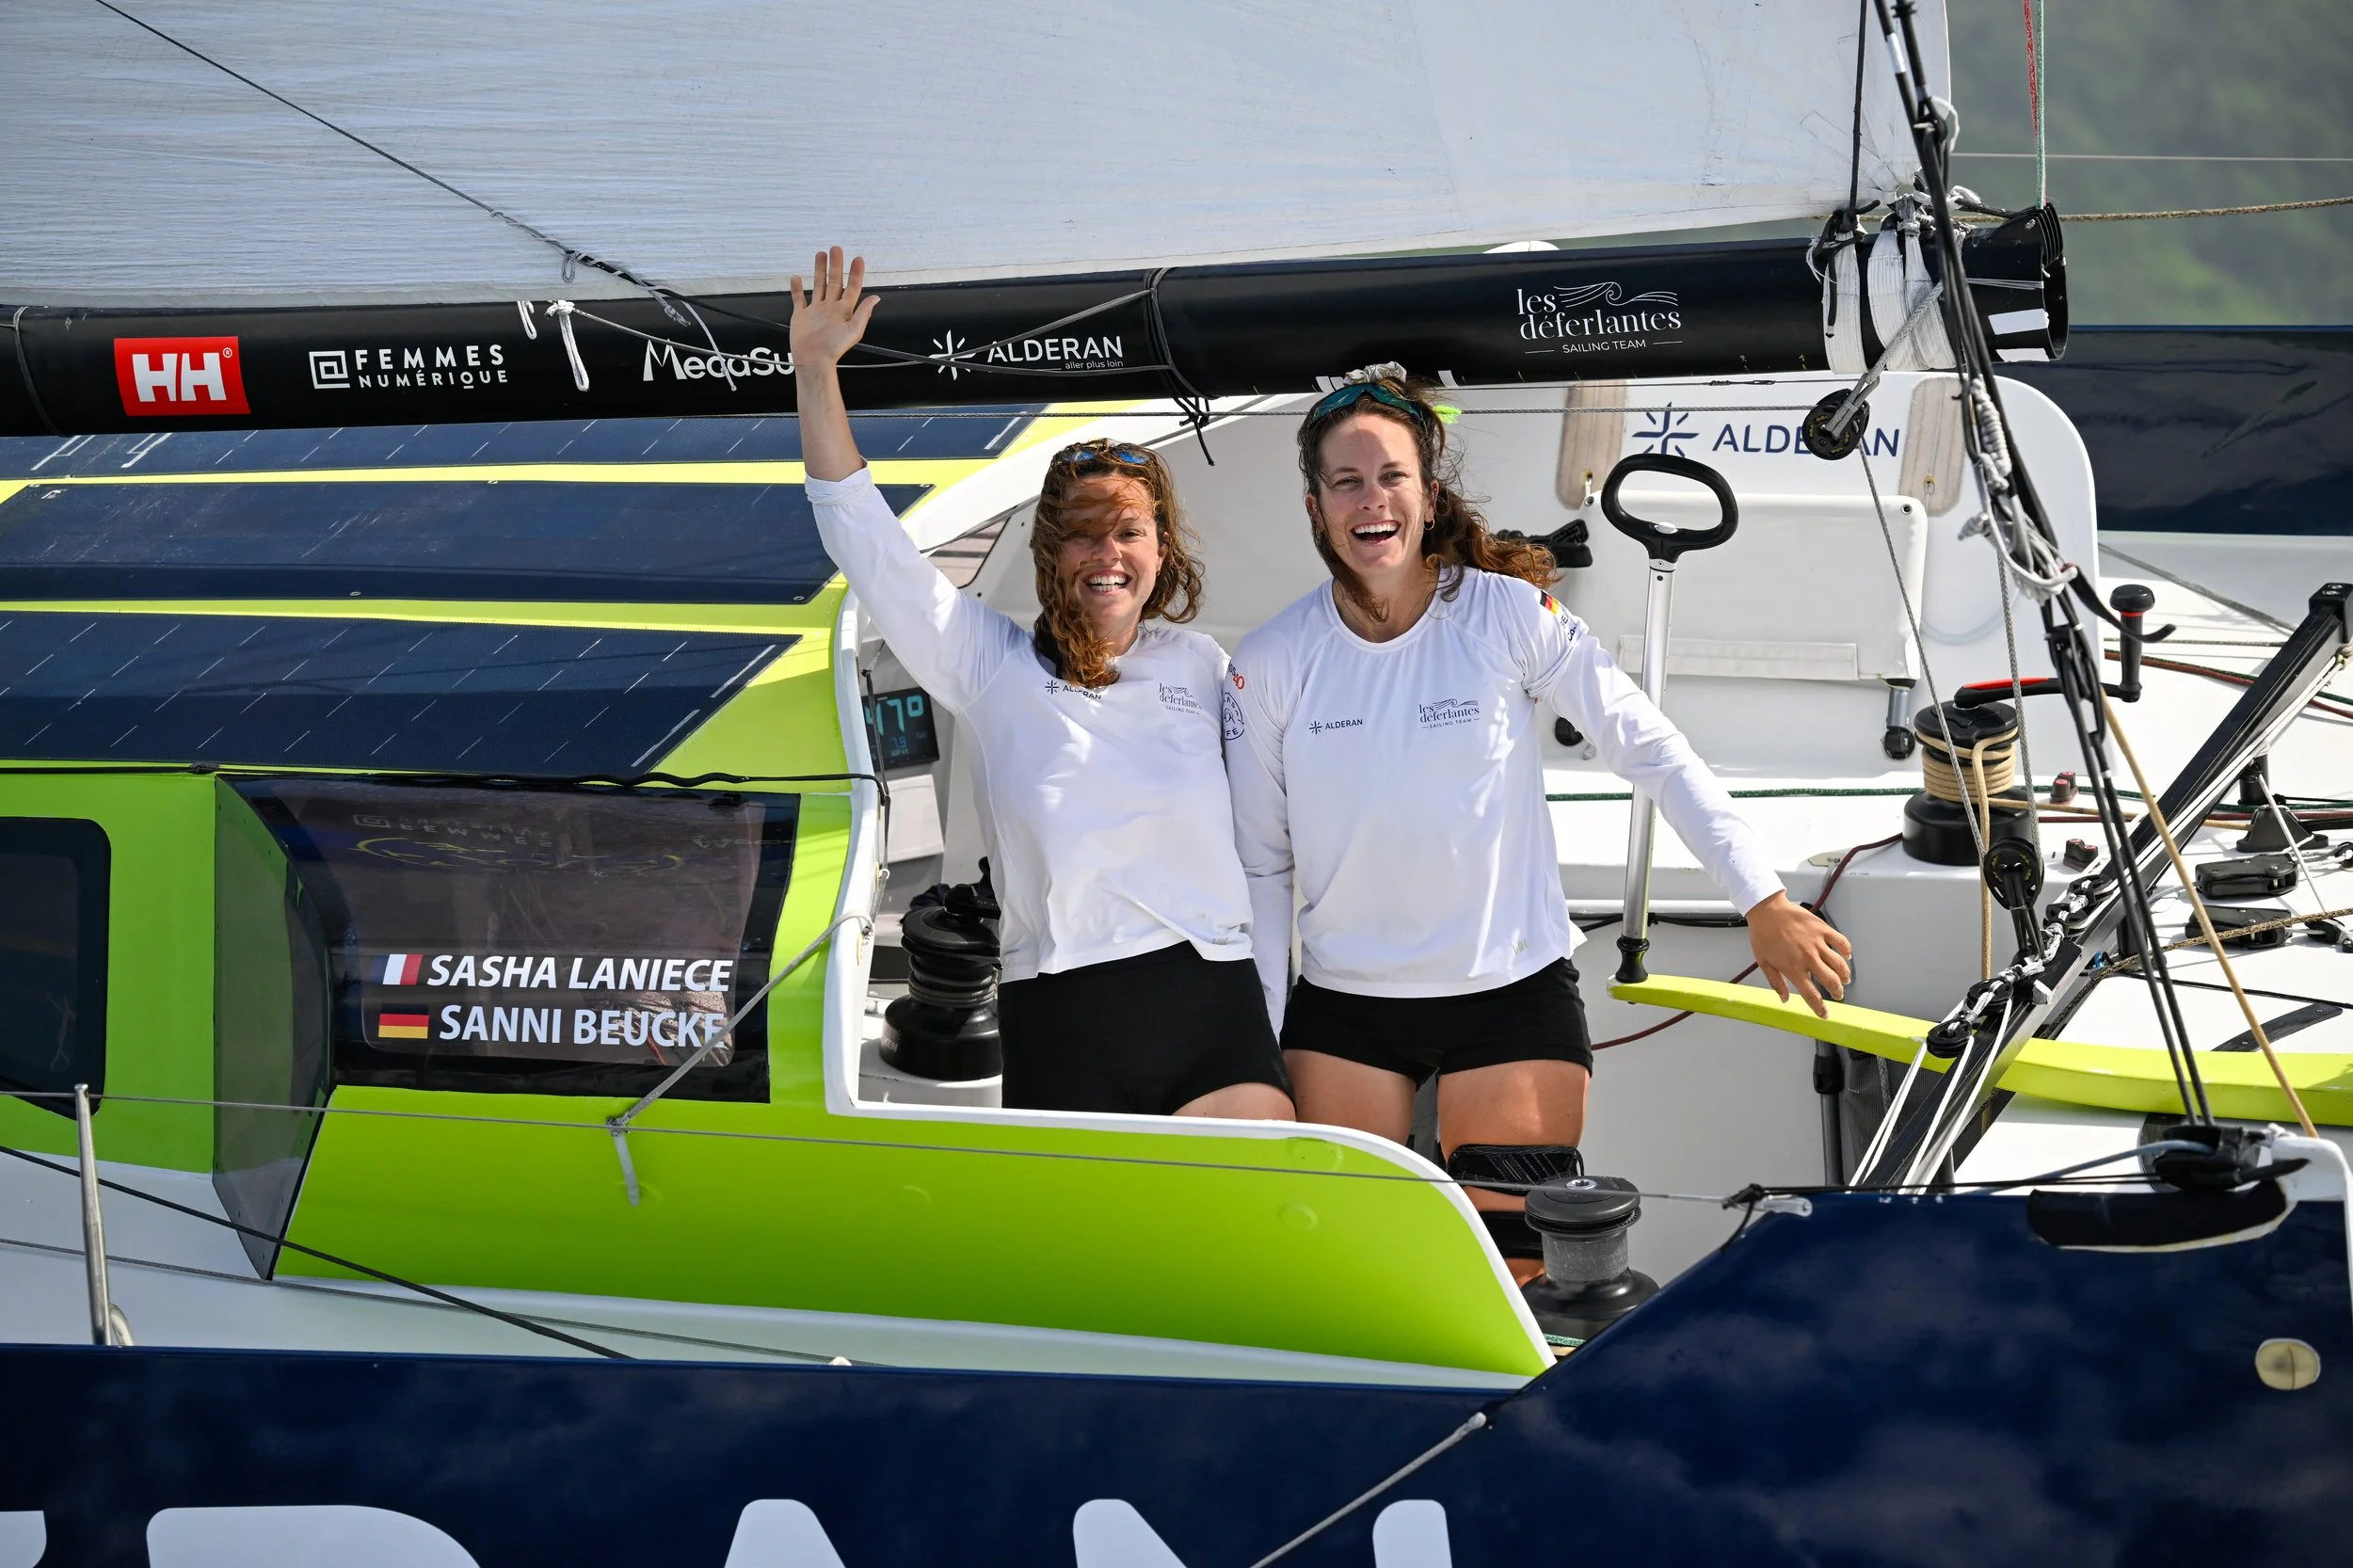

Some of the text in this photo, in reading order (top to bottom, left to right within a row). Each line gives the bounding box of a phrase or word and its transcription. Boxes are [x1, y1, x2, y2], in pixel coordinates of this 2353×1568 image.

[1516, 288, 1557, 315] les
[1520, 309, 1682, 340] déferlantes
[987, 336, 1124, 362] ALDERAN
[1562, 339, 1647, 354] SAILING TEAM
[355, 344, 504, 371] FEMMES
[643, 339, 796, 381] MecaSu
[1064, 360, 1124, 371] aller plus loin
[359, 370, 508, 390] NUMÉRIQUE
[1712, 424, 1900, 457] ALDEN
[1063, 684, 1102, 700] ALRAN
[1159, 682, 1173, 694] les
[1419, 704, 1434, 714] les
[1419, 706, 1481, 724] déferlantes
[1324, 718, 1364, 730] ALDERAN
[1429, 721, 1453, 729] SAILING
[426, 954, 733, 992] SASHA LANIECE
[439, 1004, 726, 1048] SANNI BEUCKE
